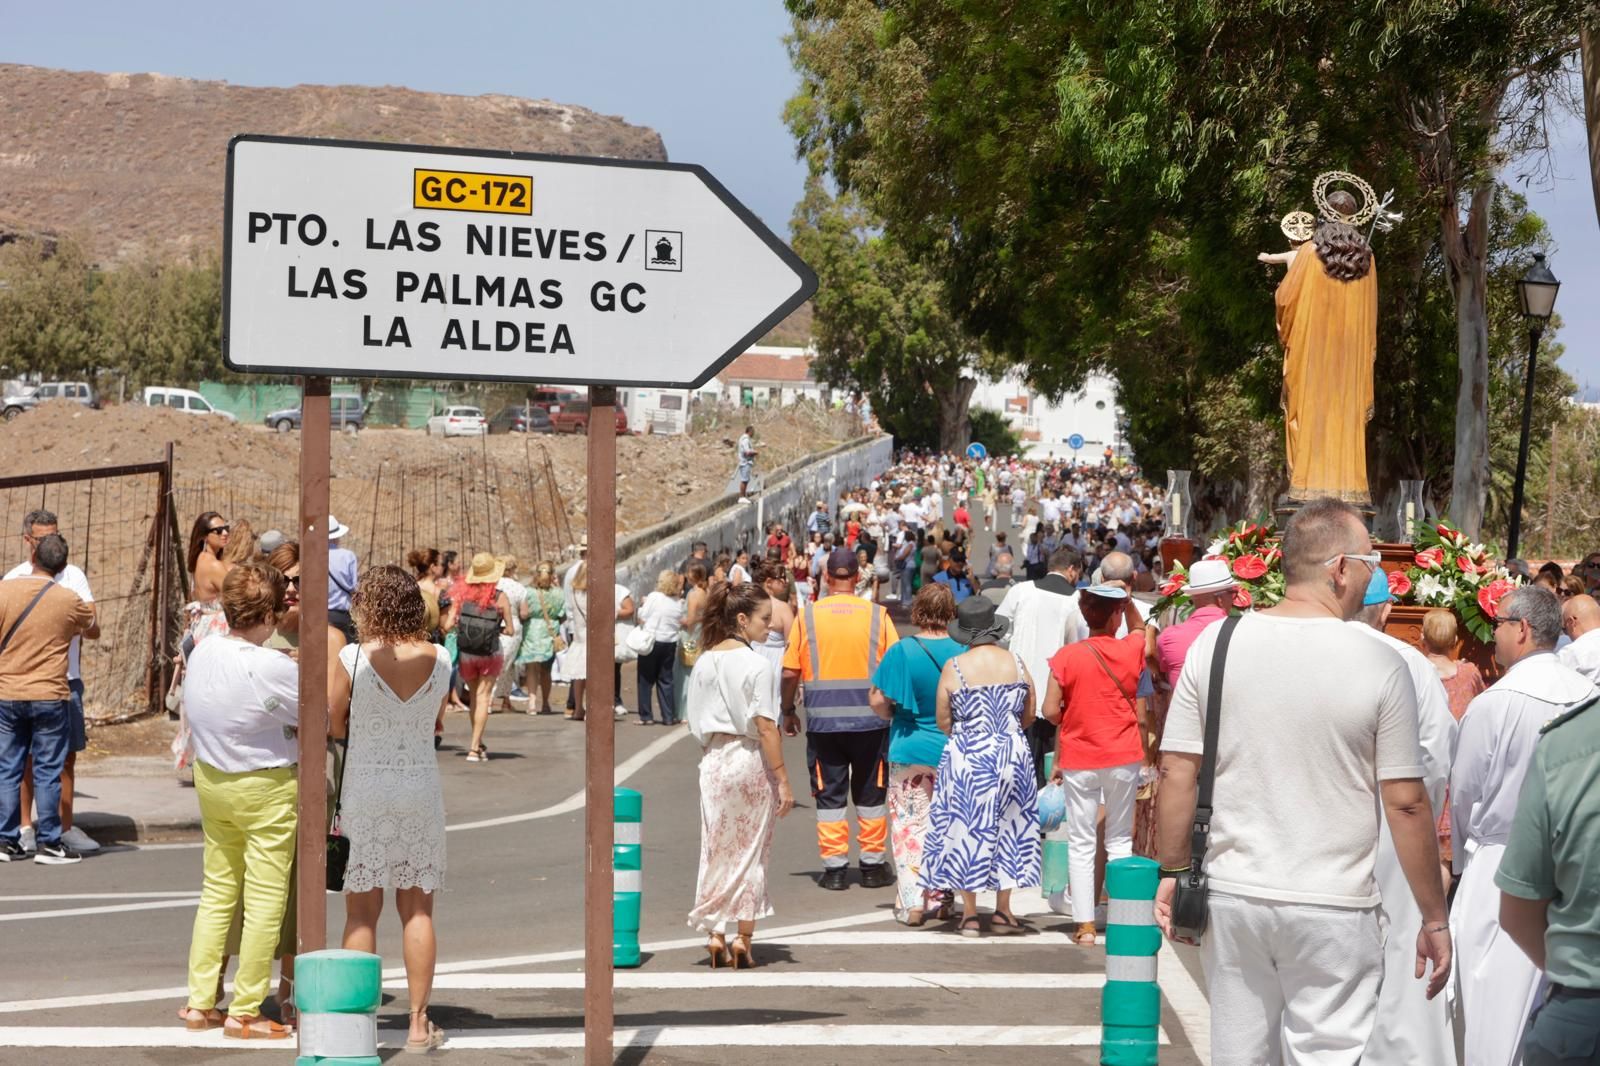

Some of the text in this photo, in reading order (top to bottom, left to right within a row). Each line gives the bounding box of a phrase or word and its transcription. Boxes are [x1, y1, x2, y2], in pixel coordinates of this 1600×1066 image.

[421, 176, 526, 208] GC-172
[248, 211, 341, 248] PTO.
[366, 218, 442, 253] LAS
[288, 265, 646, 314] LAS PALMAS GC
[363, 314, 575, 355] LA ALDEA
